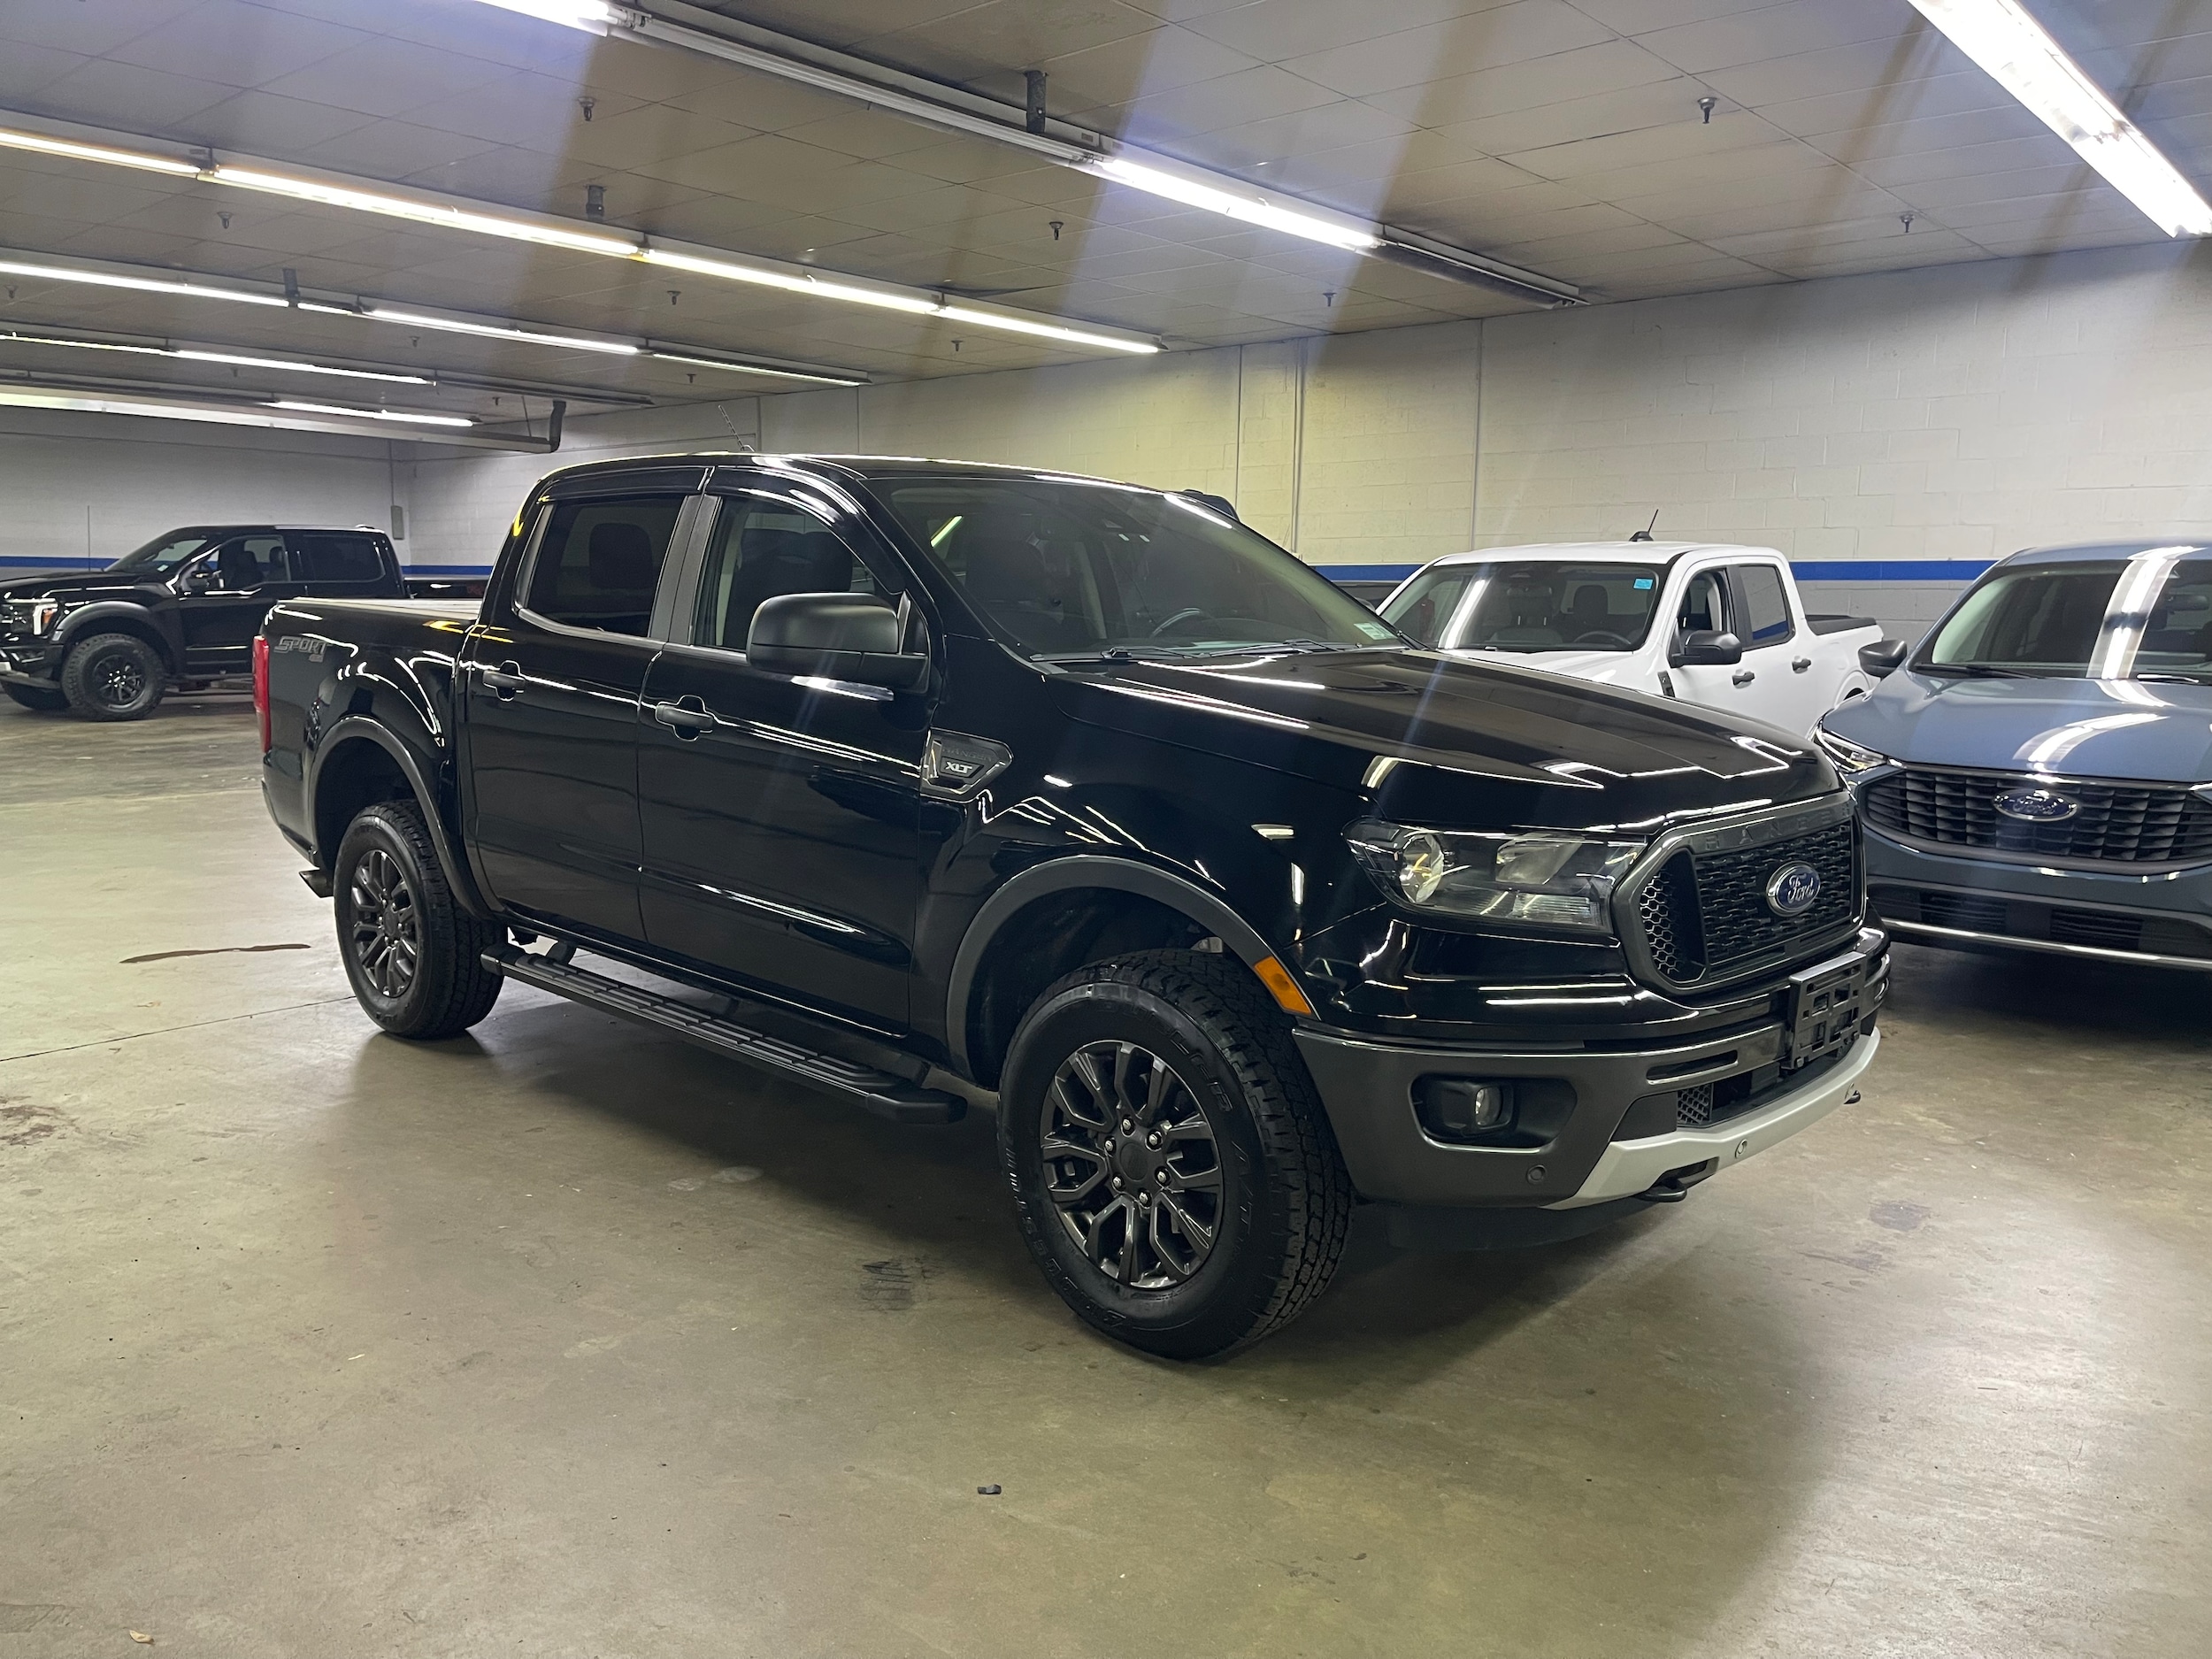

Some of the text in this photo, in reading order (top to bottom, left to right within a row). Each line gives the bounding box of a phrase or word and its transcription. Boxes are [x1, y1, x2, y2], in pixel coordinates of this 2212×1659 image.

[273, 635, 333, 655] SPORT
[945, 762, 972, 773] XLT
[1787, 874, 1815, 904] Ford
